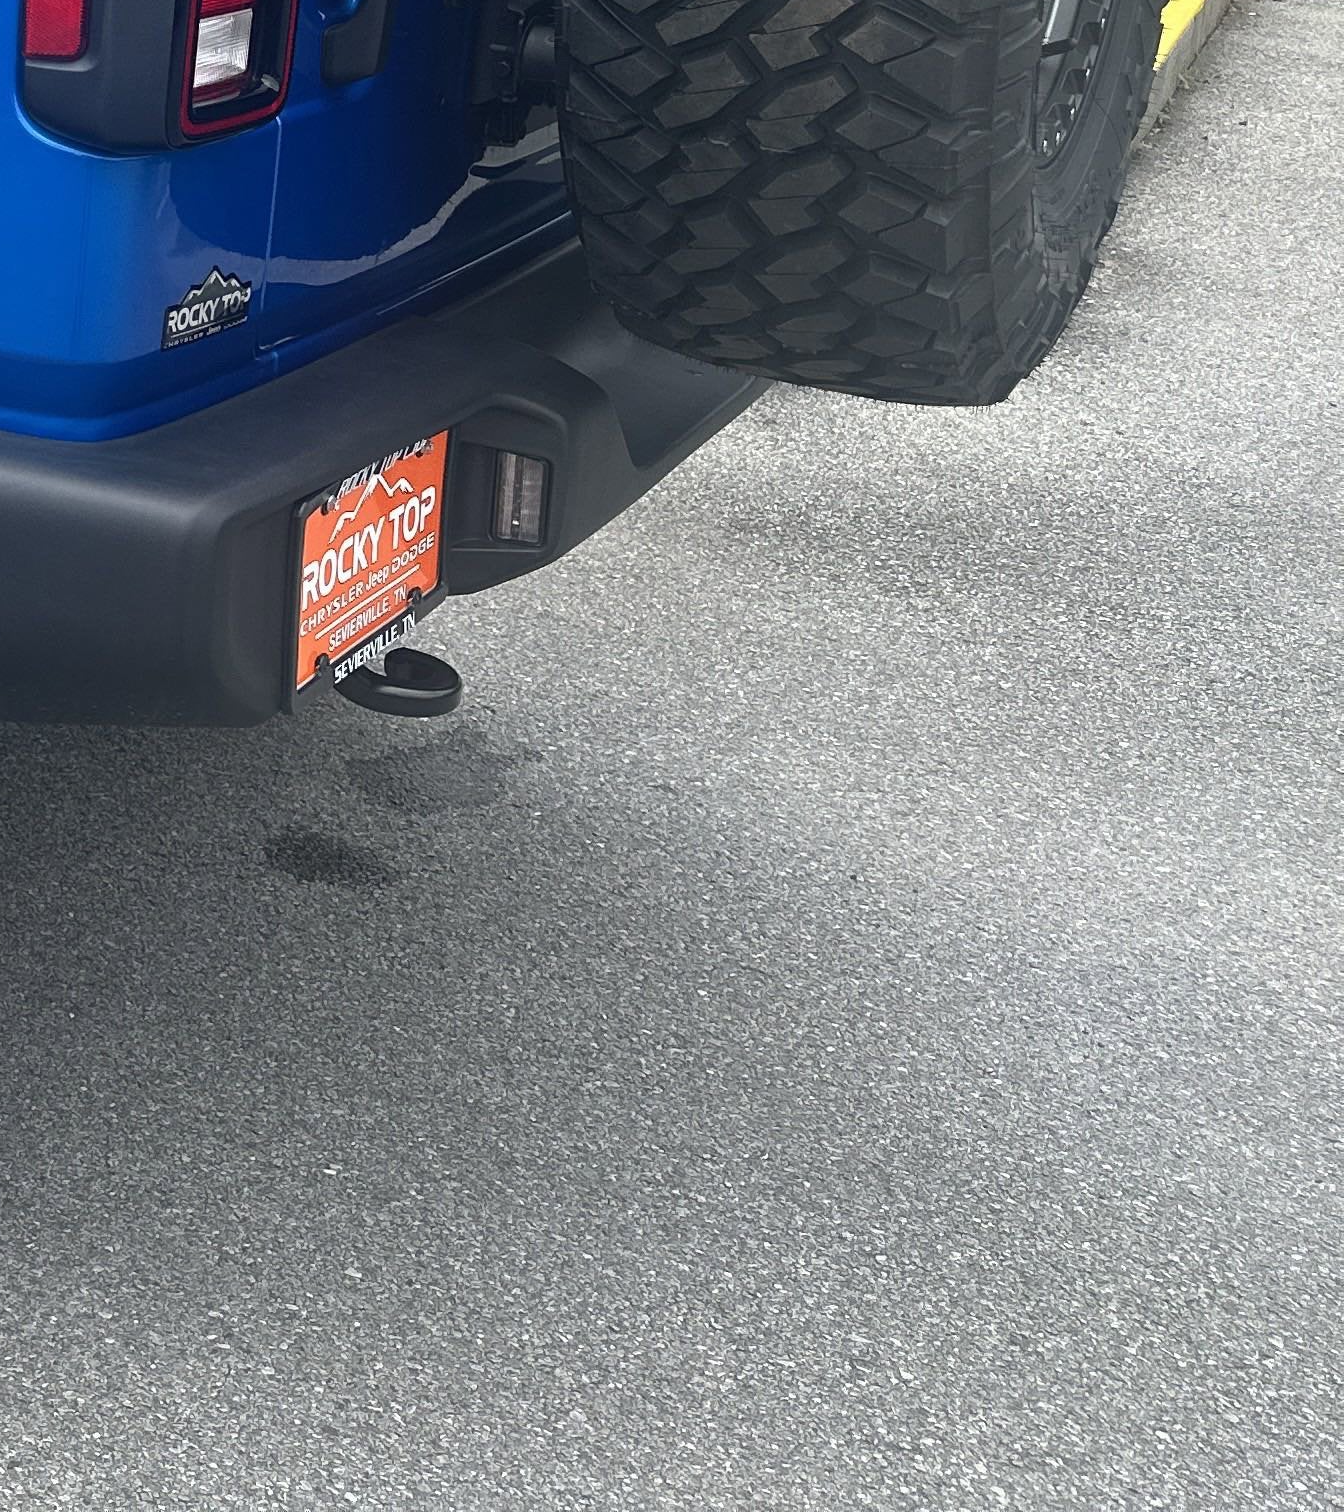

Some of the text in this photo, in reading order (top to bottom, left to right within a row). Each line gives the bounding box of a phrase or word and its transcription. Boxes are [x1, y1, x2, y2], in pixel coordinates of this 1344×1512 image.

[168, 297, 220, 334] ROCKY
[222, 287, 251, 315] TOP
[299, 532, 435, 637] CHRYSLER Jeep DODGE
[301, 485, 436, 612] ROCKY TOP
[328, 584, 408, 652] SEVIERVILLE, TN
[334, 611, 416, 684] SEVIERVILLE, TN
